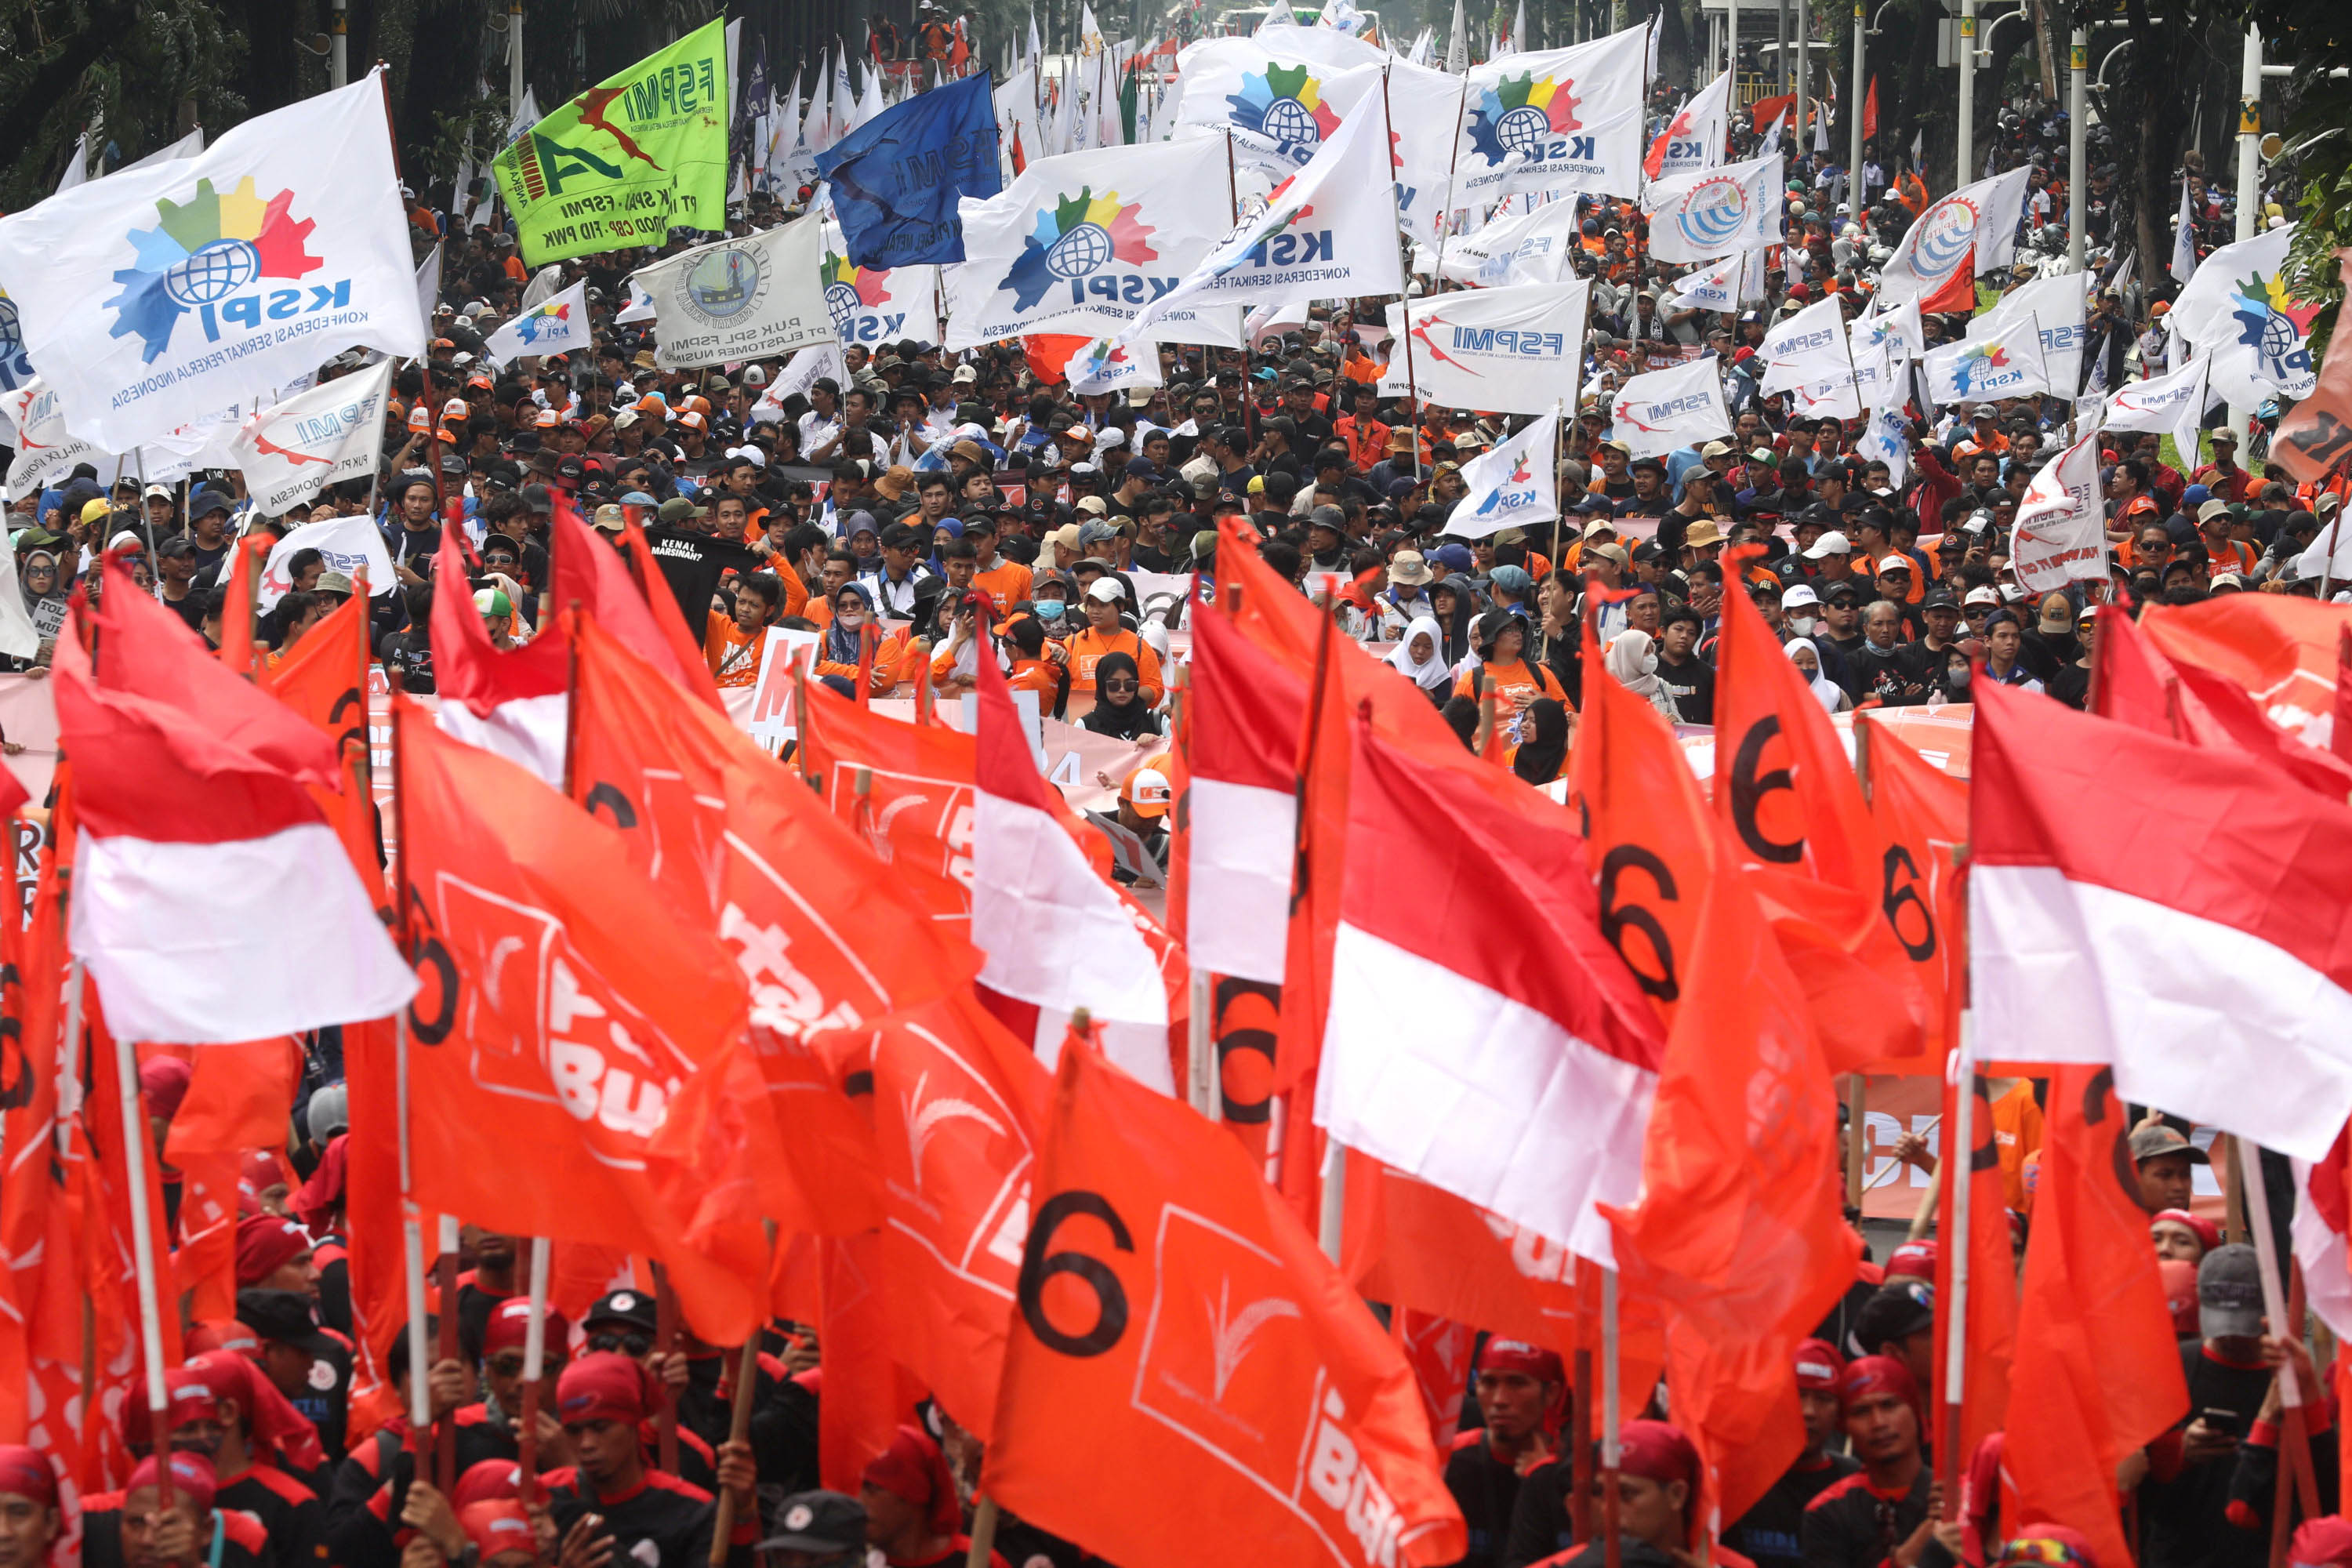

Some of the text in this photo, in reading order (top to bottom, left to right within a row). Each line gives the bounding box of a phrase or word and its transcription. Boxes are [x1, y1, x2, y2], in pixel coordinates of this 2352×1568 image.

[651, 546, 703, 562] MARSINAH?
[661, 539, 696, 553] KENAL
[1730, 714, 1805, 863] 6
[1600, 844, 1679, 1003] 6
[1882, 843, 1936, 962] 6
[1018, 1190, 1136, 1358] 6
